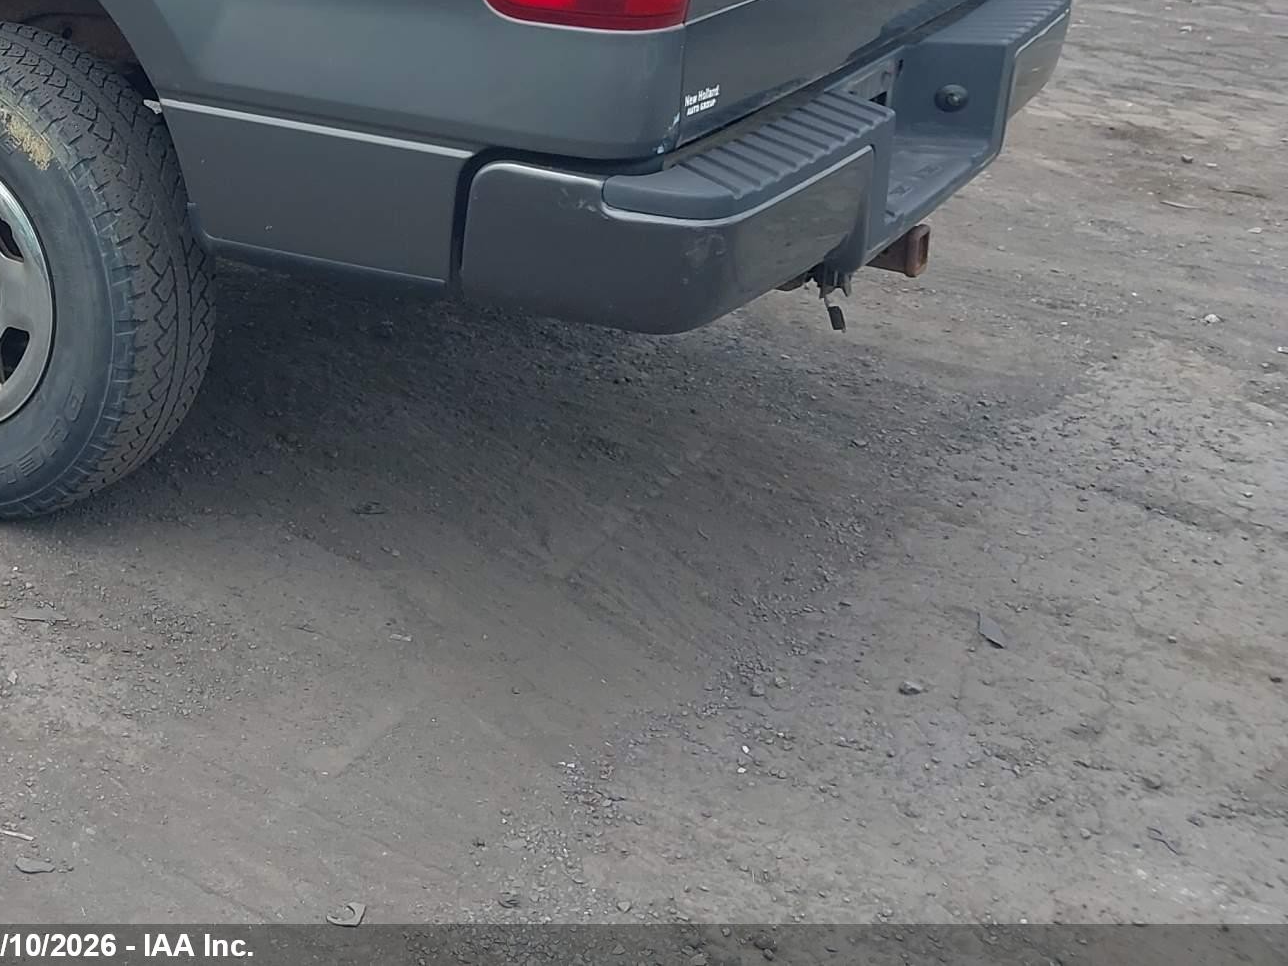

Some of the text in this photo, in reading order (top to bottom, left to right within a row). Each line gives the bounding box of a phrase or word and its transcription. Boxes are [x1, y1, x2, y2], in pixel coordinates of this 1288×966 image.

[684, 84, 720, 107] New Holland
[686, 104, 700, 117] AUTO
